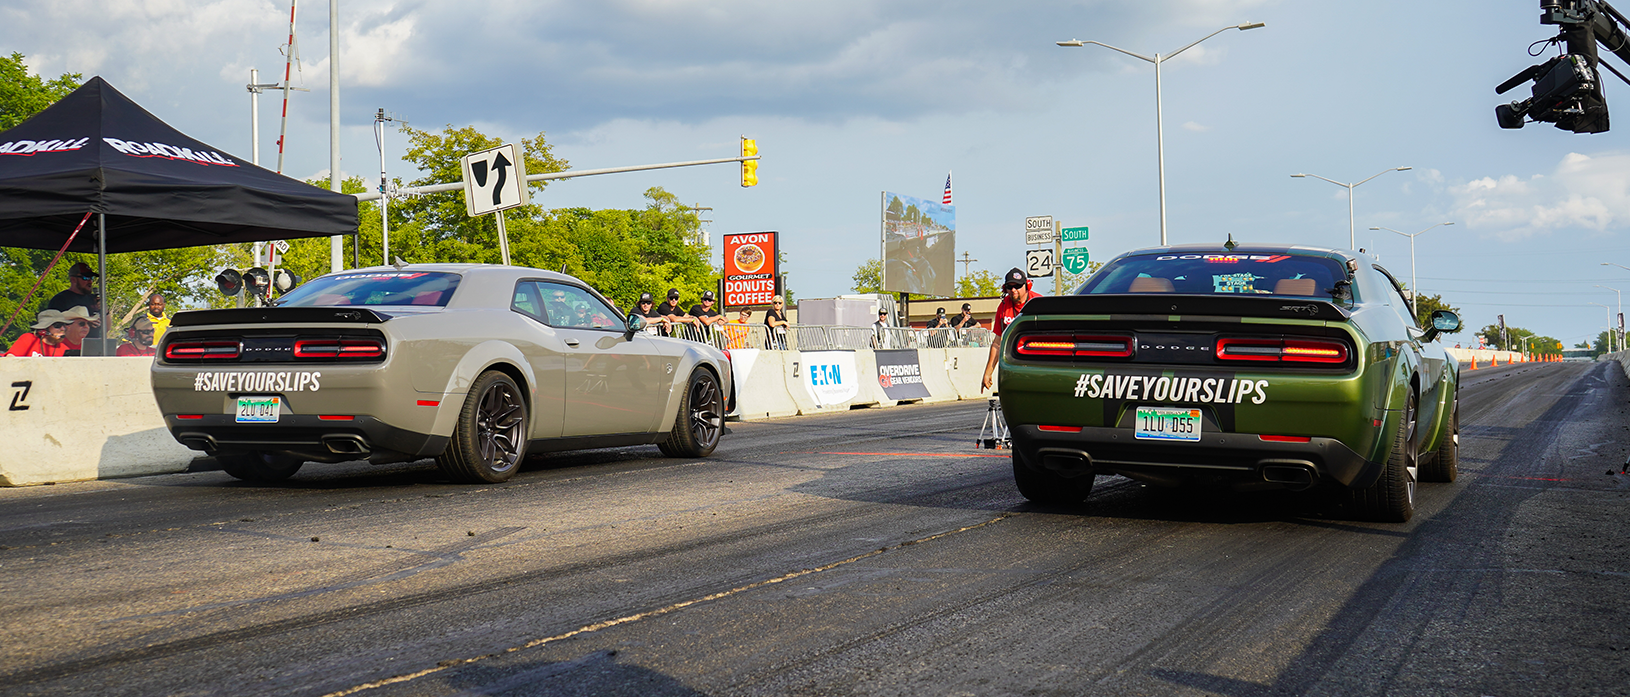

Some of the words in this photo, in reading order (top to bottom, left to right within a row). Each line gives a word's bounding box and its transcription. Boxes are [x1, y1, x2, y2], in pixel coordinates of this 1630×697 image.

[0, 137, 89, 153] ADKILL
[103, 137, 236, 165] ROADKILL
[1027, 219, 1051, 229] SOUTH
[730, 234, 769, 245] AVON
[1027, 232, 1051, 242] BUSINESS
[1063, 229, 1087, 240] SOUTH
[1029, 255, 1051, 271] 24
[1066, 255, 1086, 269] 75
[728, 273, 771, 281] GOURMET
[725, 280, 774, 293] DONUTS
[728, 292, 772, 305] COFFEE
[810, 364, 842, 386] EATON
[880, 364, 920, 376] OVERDRIVE
[194, 371, 322, 392] #SAVEYOURSLIPS
[1074, 374, 1269, 404] #SAVEYOURSLIPS
[241, 403, 256, 417] 2LU
[1143, 416, 1165, 432] 1LU
